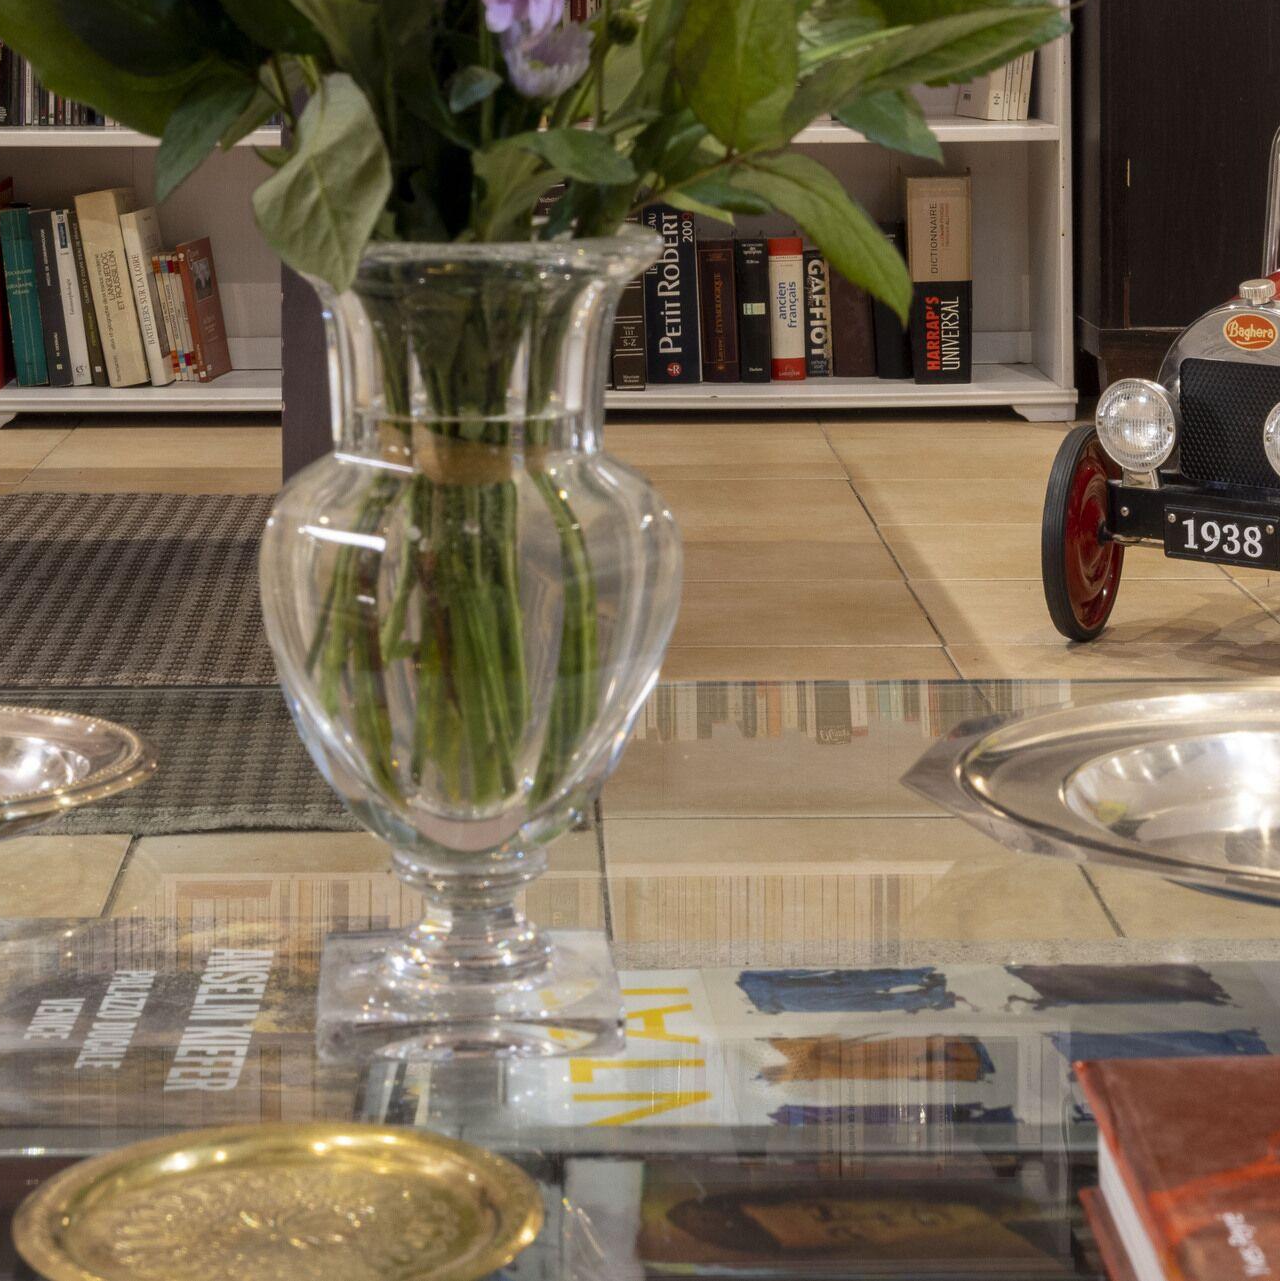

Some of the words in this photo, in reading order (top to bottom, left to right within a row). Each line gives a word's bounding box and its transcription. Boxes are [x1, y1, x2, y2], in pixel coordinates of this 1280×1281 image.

[682, 212, 694, 243] 2009
[929, 202, 939, 274] DICTIONNAIRE
[100, 252, 117, 302] LANGUEDOC
[108, 249, 124, 299] ROUSSILLON
[131, 254, 143, 278] LOIRE
[140, 305, 156, 345] BATELIERS
[777, 281, 787, 320] ancien
[786, 280, 798, 329] français
[807, 259, 827, 357] GAFFIOT
[622, 338, 637, 347] S-Z
[924, 296, 940, 371] HARRAP'S
[940, 296, 960, 370] UNIVERSAL
[1224, 320, 1277, 343] Baghera
[1182, 518, 1263, 559] 1938
[104, 969, 157, 1018] PALAZZO
[190, 947, 273, 1024] ANSELM
[23, 997, 84, 1040] VENICE
[74, 1019, 141, 1069] DUCALE
[163, 1027, 255, 1092] KIEFER
